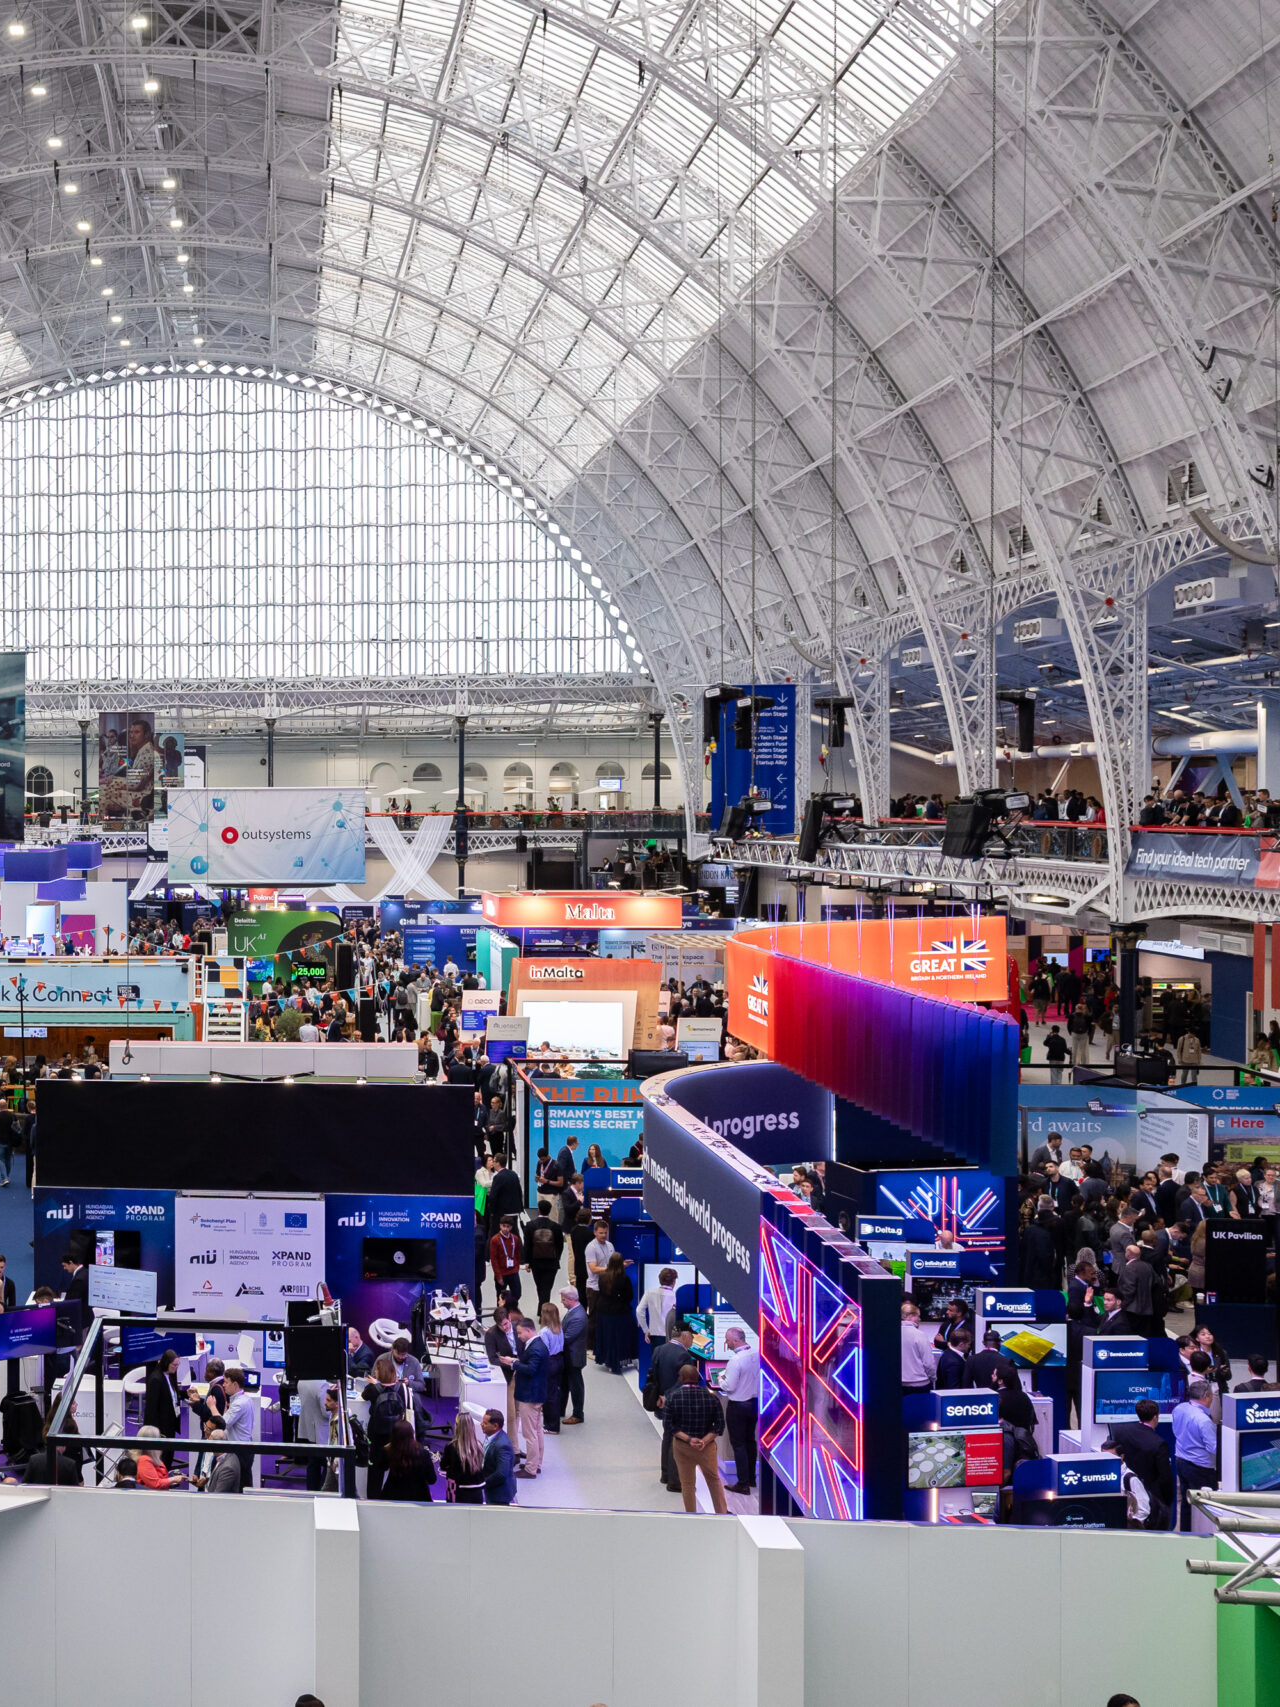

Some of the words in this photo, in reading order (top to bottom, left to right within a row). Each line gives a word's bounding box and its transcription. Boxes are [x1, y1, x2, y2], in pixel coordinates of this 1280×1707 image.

[242, 828, 312, 842] outsystems
[1136, 848, 1152, 864] Find
[1153, 852, 1172, 868] your
[1172, 850, 1194, 867] ideal
[1195, 852, 1213, 869] tech
[1214, 855, 1250, 872] partner
[565, 904, 616, 920] Malta
[234, 936, 257, 952] UK
[530, 966, 584, 980] inMalta
[910, 960, 956, 973] GREAT
[13, 986, 29, 1002] &
[33, 986, 112, 1002] Connect
[594, 1087, 643, 1102] RUH
[534, 1109, 601, 1119] GRMANY'S
[605, 1110, 633, 1119] BEST
[593, 1121, 638, 1129] SECRET
[712, 1111, 799, 1139] progress
[1048, 1119, 1102, 1133] awaits
[1230, 1117, 1264, 1128] Here
[126, 1205, 164, 1215] XPAND
[650, 1157, 671, 1192] meets
[671, 1178, 710, 1234] real-world
[711, 1214, 751, 1274] progress
[421, 1212, 461, 1222] XPAND
[875, 1226, 902, 1236] Delta.g
[1228, 1232, 1263, 1240] Pavilion
[272, 1251, 311, 1260] XPAND
[996, 1303, 1032, 1312] Pragmatic
[946, 1403, 994, 1416] sensat
[1082, 1472, 1118, 1482] sumsub
